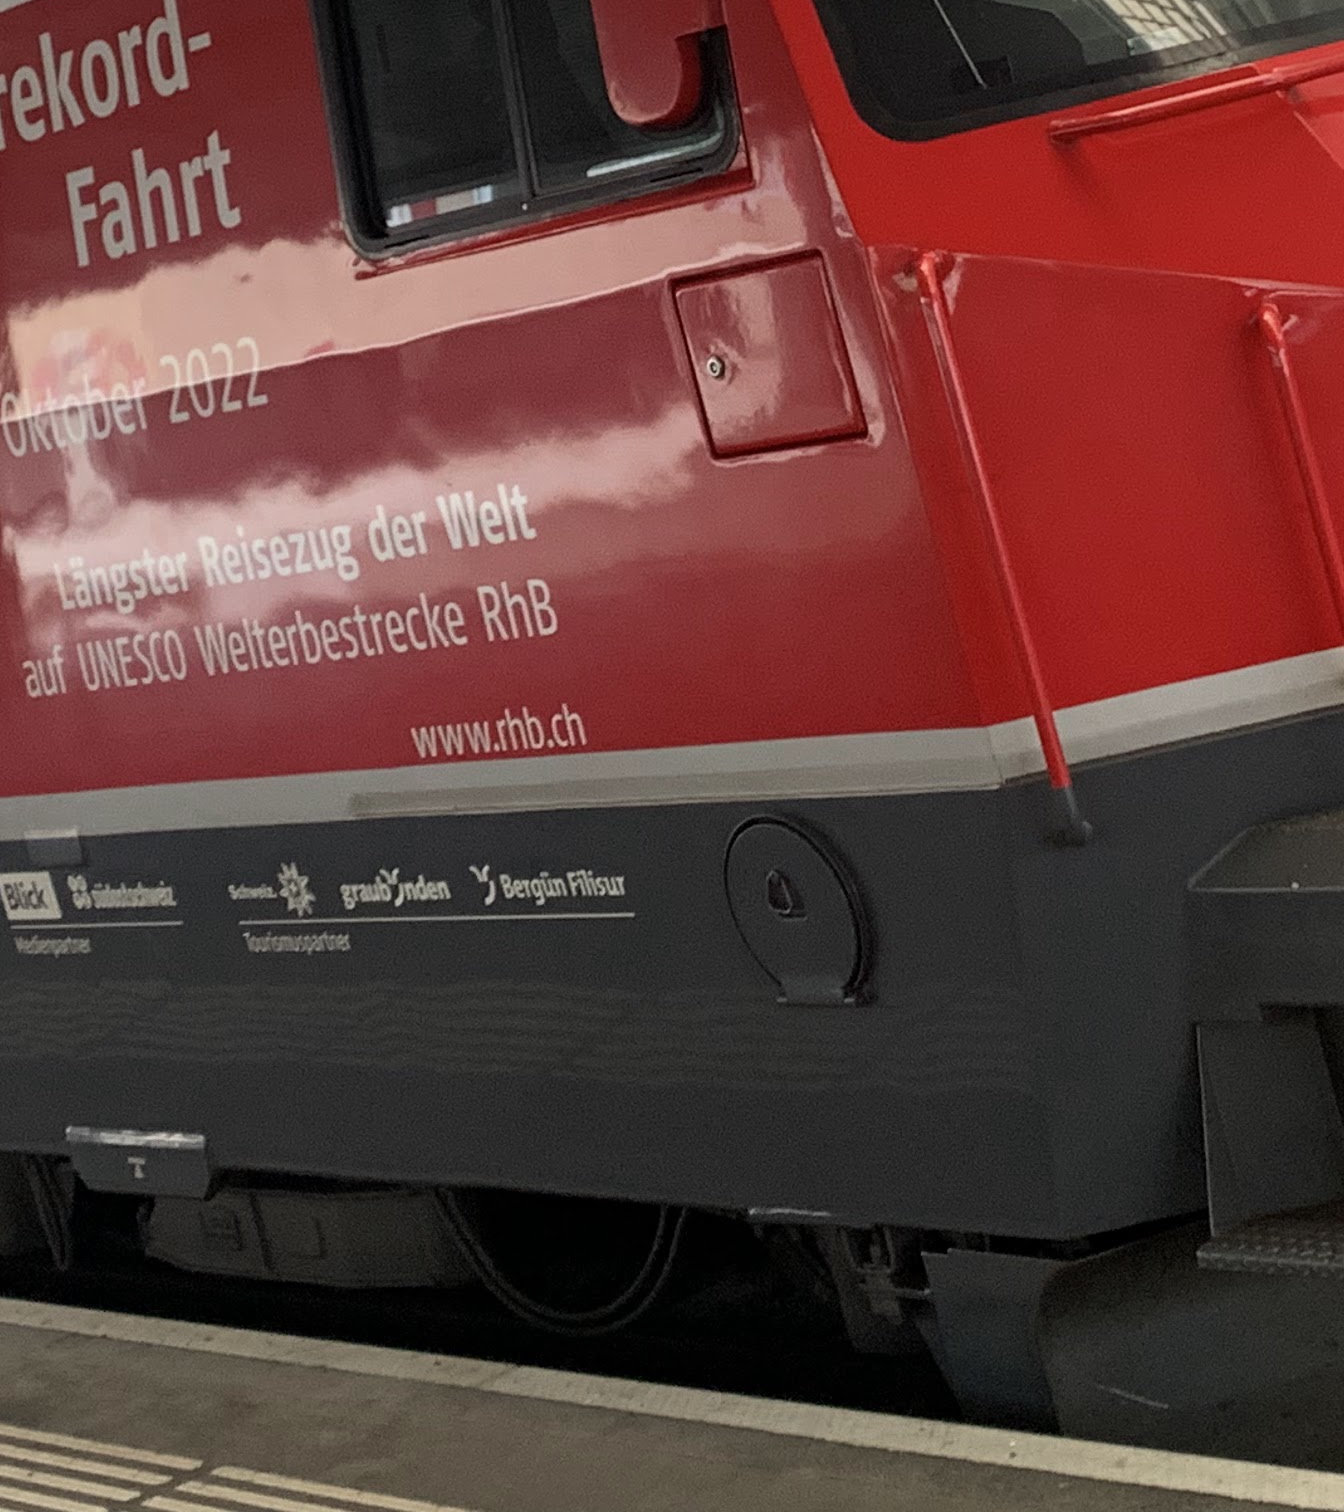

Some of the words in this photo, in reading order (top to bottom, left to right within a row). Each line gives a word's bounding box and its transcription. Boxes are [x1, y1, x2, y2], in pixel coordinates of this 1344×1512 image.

[66, 129, 243, 267] Fahrt
[0, 376, 151, 458] Oktober
[159, 336, 269, 424] 2022
[54, 546, 189, 616] Längster
[198, 522, 360, 587] Reisezug
[366, 494, 429, 562] der
[437, 482, 537, 552] Welt
[22, 647, 67, 698] auf
[77, 629, 186, 694] UNESCO
[194, 600, 469, 678] Welterbestrecke
[477, 578, 559, 643] RhB
[411, 702, 588, 759] www.rhb.ch
[3, 880, 49, 911] Blick
[499, 872, 569, 906] Bergün
[567, 868, 626, 898] Filisur
